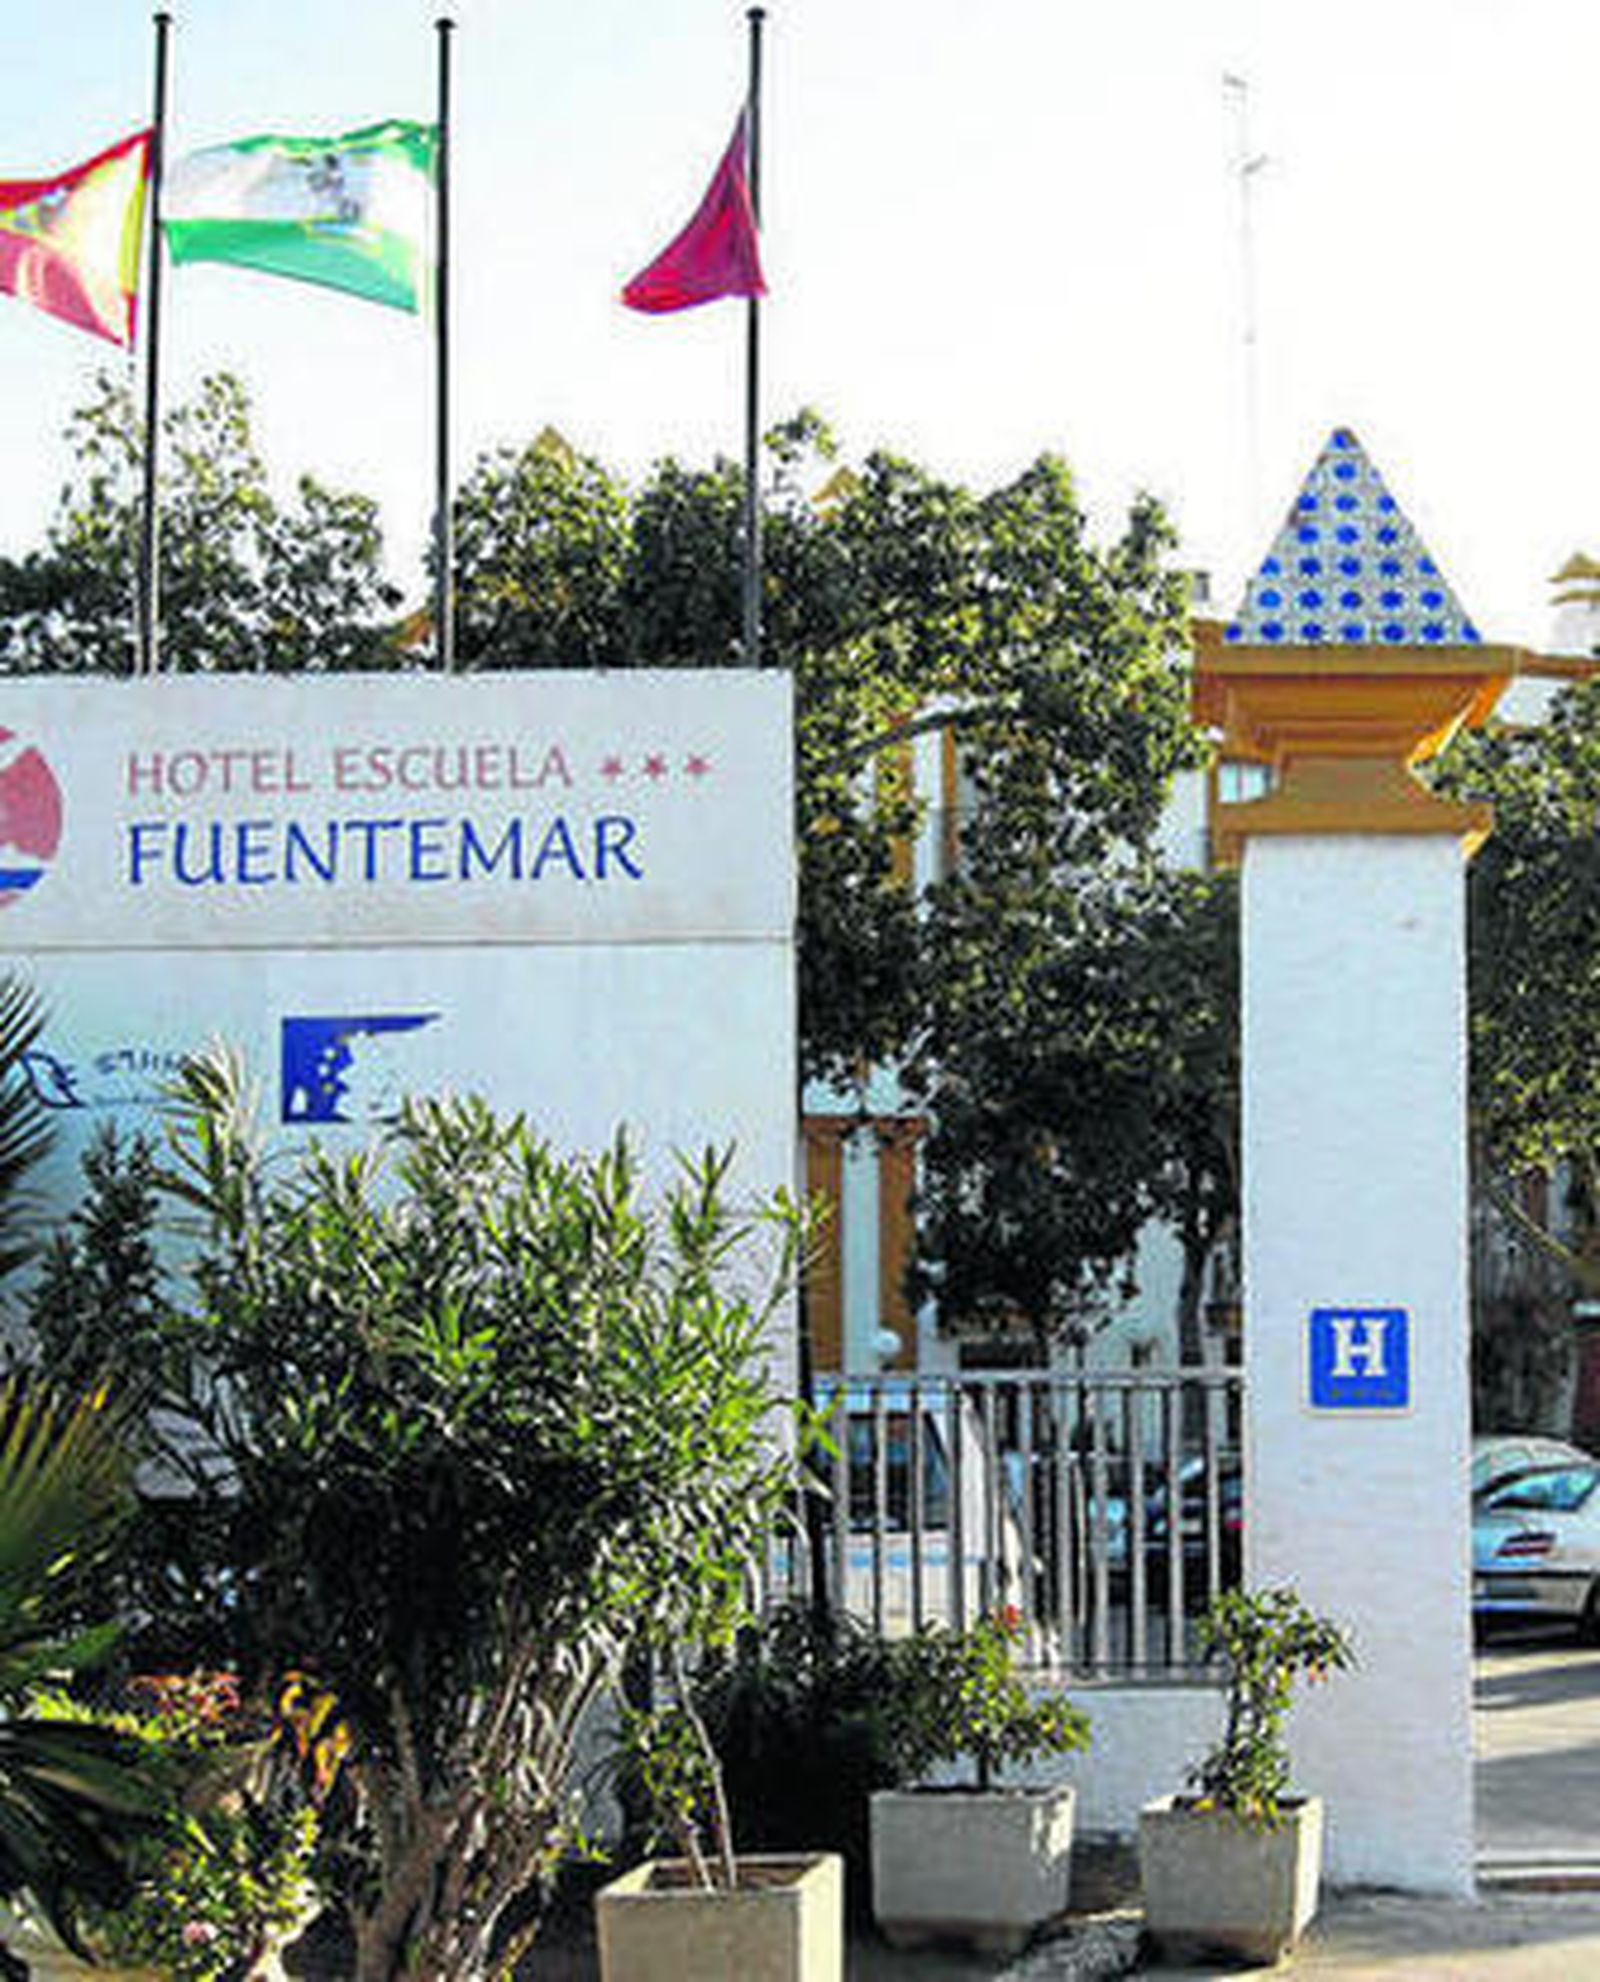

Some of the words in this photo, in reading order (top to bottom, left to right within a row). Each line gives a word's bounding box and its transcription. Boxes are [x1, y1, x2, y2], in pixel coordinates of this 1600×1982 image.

[127, 751, 311, 795] HOTEL
[333, 746, 573, 791] ESCUELA
[129, 815, 643, 885] FUENTEMAR
[1331, 1318, 1388, 1376] H
